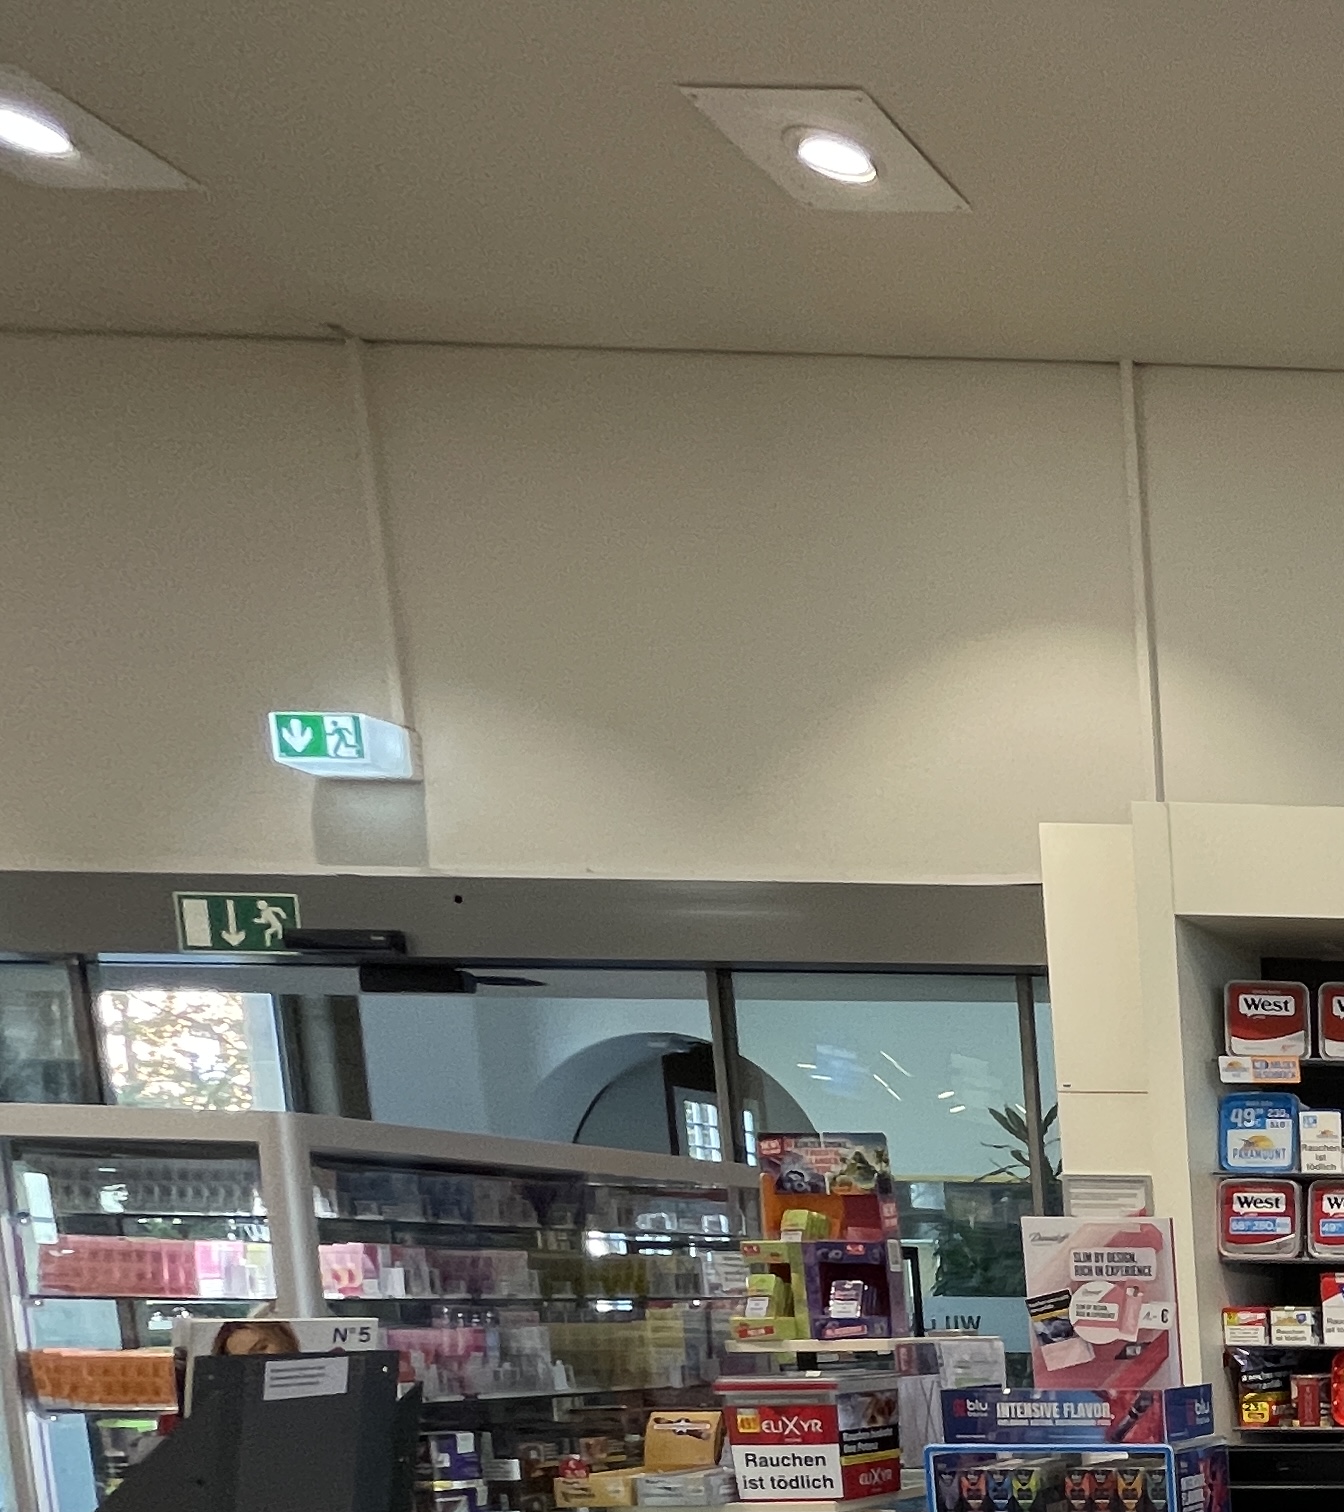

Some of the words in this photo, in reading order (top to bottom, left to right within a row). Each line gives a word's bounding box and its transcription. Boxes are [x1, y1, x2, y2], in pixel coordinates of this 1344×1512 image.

[1243, 998, 1290, 1012] West
[1232, 1148, 1286, 1160] PARAMOUNT
[1237, 1195, 1283, 1209] West
[967, 1400, 988, 1411] blu
[997, 1402, 1060, 1419] INTENSIVE
[1063, 1402, 1115, 1419] FLAVOR.
[1194, 1400, 1210, 1415] blu
[745, 1453, 826, 1468] Rauchen
[742, 1475, 765, 1489] ist
[770, 1474, 834, 1489] tödlich
